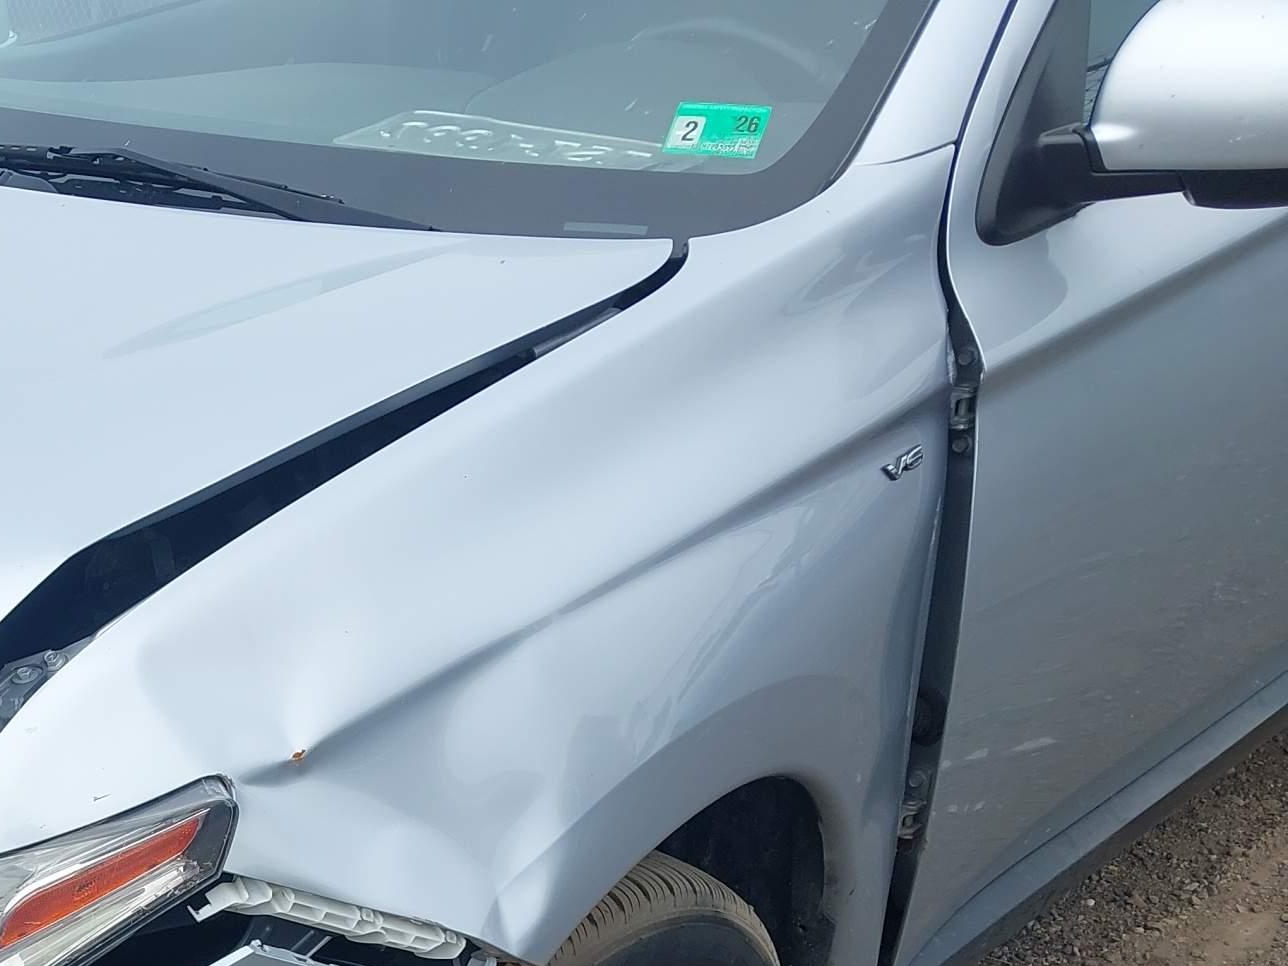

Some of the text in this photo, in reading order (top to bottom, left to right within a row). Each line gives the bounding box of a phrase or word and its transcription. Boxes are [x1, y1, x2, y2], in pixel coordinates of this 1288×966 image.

[680, 120, 699, 142] 2
[736, 115, 761, 133] 26
[880, 444, 923, 481] V6
